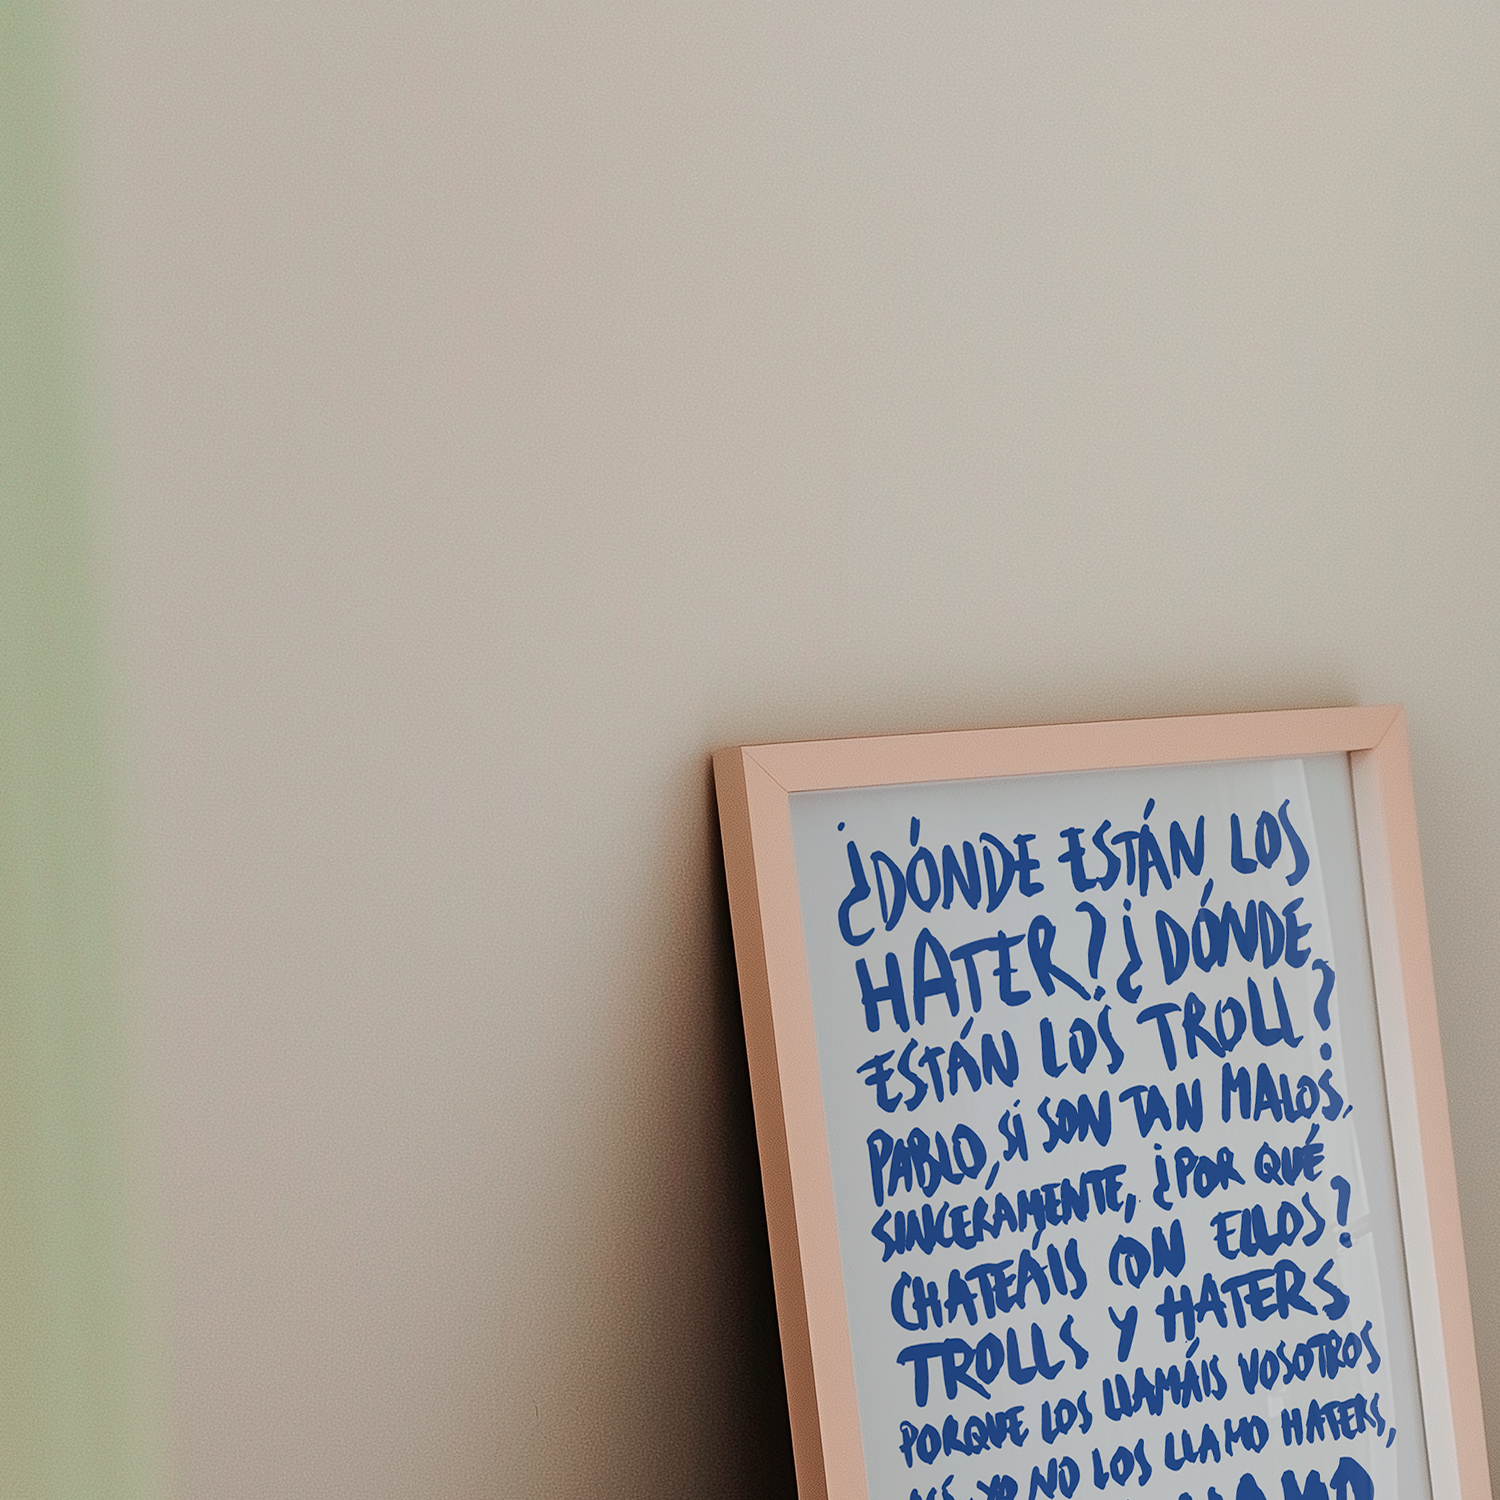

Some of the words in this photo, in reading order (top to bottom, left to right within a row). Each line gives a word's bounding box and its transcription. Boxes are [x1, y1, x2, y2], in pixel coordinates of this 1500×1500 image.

[1057, 797, 1205, 898] ESTÁN
[1230, 798, 1310, 887] LOS
[856, 1016, 1020, 1113] ESTÁN
[1039, 1004, 1125, 1079] LOS
[866, 1123, 1000, 1208] PABLO,
[1036, 1090, 1112, 1154] SON
[1118, 1077, 1204, 1139] TAN
[1221, 1061, 1354, 1124] MALOS,
[1253, 1122, 1326, 1187] QUÉ
[1108, 1218, 1187, 1290] CON
[896, 1314, 1090, 1408] TROLLS
[1107, 1305, 1139, 1363] Y
[1154, 1258, 1351, 1343] HATERS
[898, 1405, 1030, 1469] PORQUE
[1041, 1389, 1093, 1445] LOS
[1237, 1319, 1381, 1396] VOSOTROS
[1091, 1438, 1153, 1491] LOS
[1164, 1414, 1270, 1472] LLAMO
[1280, 1392, 1397, 1449] HATERS,
